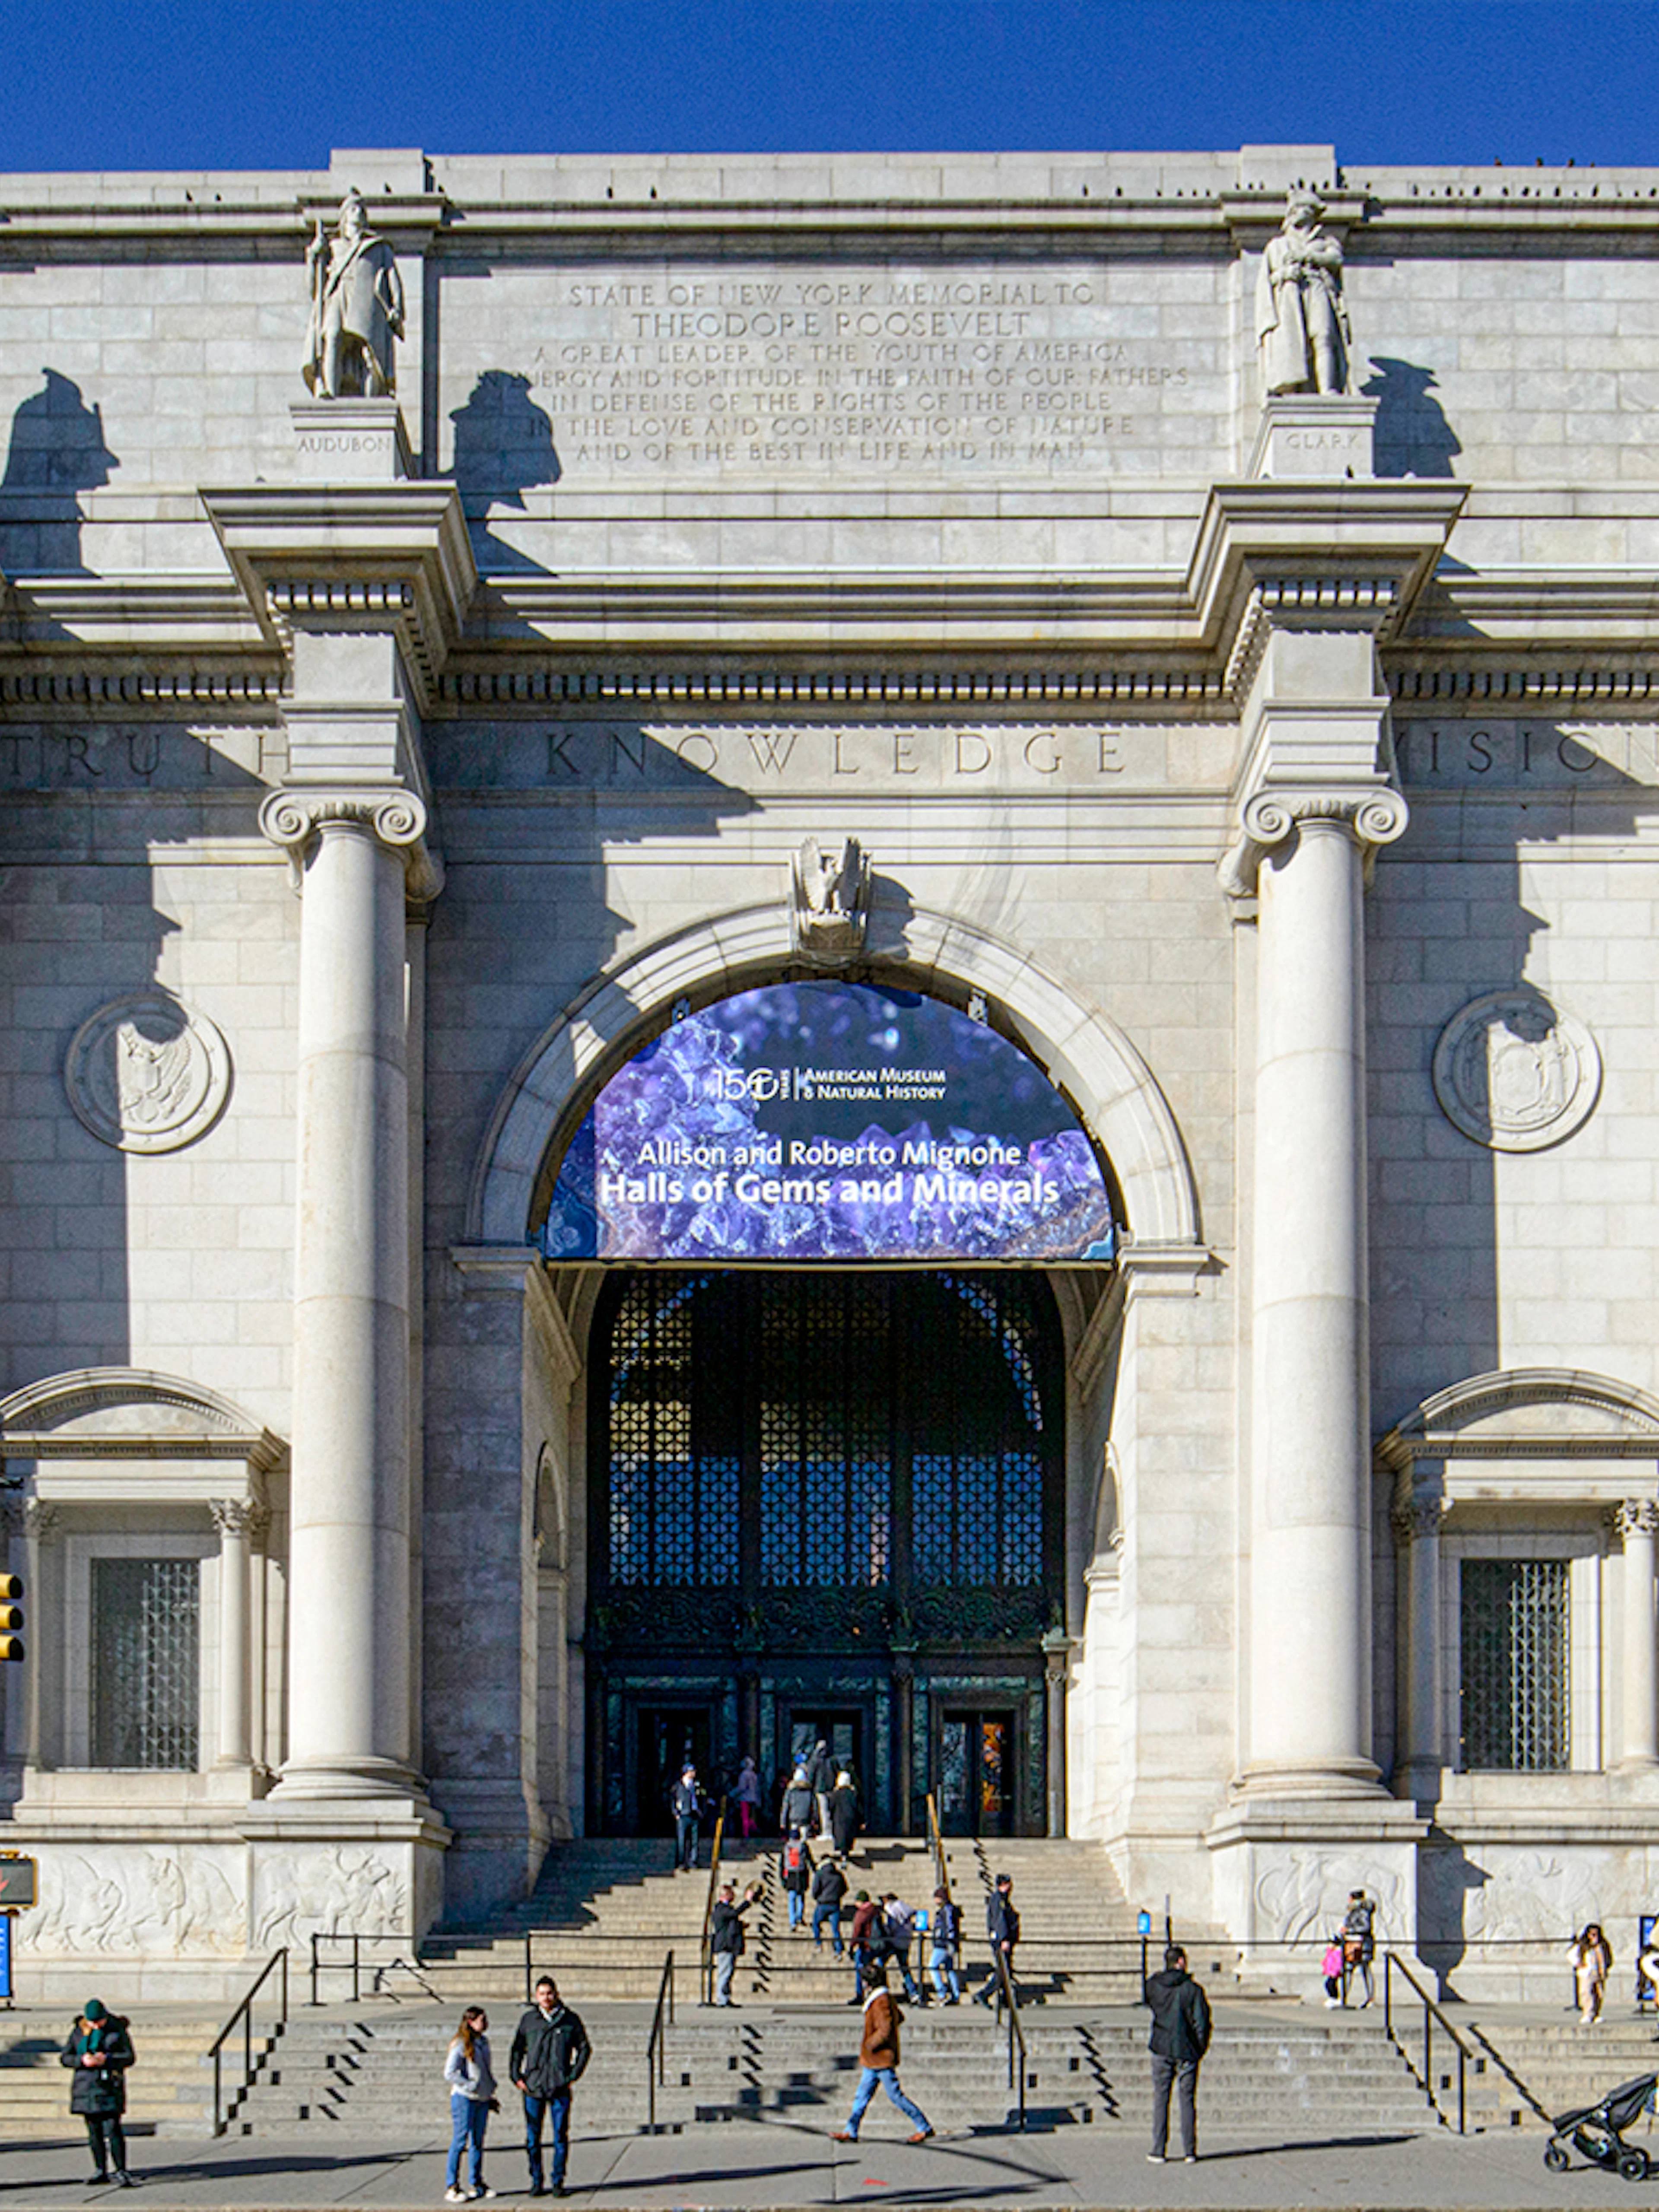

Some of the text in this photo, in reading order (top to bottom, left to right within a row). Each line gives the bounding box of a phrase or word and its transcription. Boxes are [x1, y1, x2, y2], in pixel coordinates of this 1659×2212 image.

[569, 283, 1093, 306] STATE OF NEW YORK MEMORIAL TO
[632, 312, 1030, 337] THEODORE ROOSEVELT
[535, 344, 1126, 363] A GREAT LEADER OF THE YOUTH OF AMERICA
[610, 369, 661, 388] AND
[673, 369, 804, 387] FORTITUDE
[817, 369, 841, 387] IN
[851, 369, 895, 387] THE
[906, 369, 973, 386] FAITH
[985, 368, 1015, 386] OF
[1027, 368, 1081, 386] OUR
[1090, 367, 1187, 386] FATHERS
[551, 392, 1111, 412] IN DEFENSE OF THE RIGHTS OF THE PEOPLE
[568, 419, 615, 437] THE
[629, 418, 693, 437] LOVE
[706, 418, 758, 436] AND
[771, 417, 972, 436] CONSERVATION
[985, 417, 1016, 435] OF
[1031, 416, 1134, 435] NATURE
[299, 436, 391, 452] AUDUBON
[577, 441, 1085, 461] AND OF THE BEST IN LIFE AND IN MAN
[3, 734, 289, 776] TRUTH
[546, 731, 1125, 775] KNOWLEDGE
[637, 1140, 1021, 1173] Allison and Roberto Mignone
[599, 1172, 1059, 1203] Halls of Gems and Minerals
